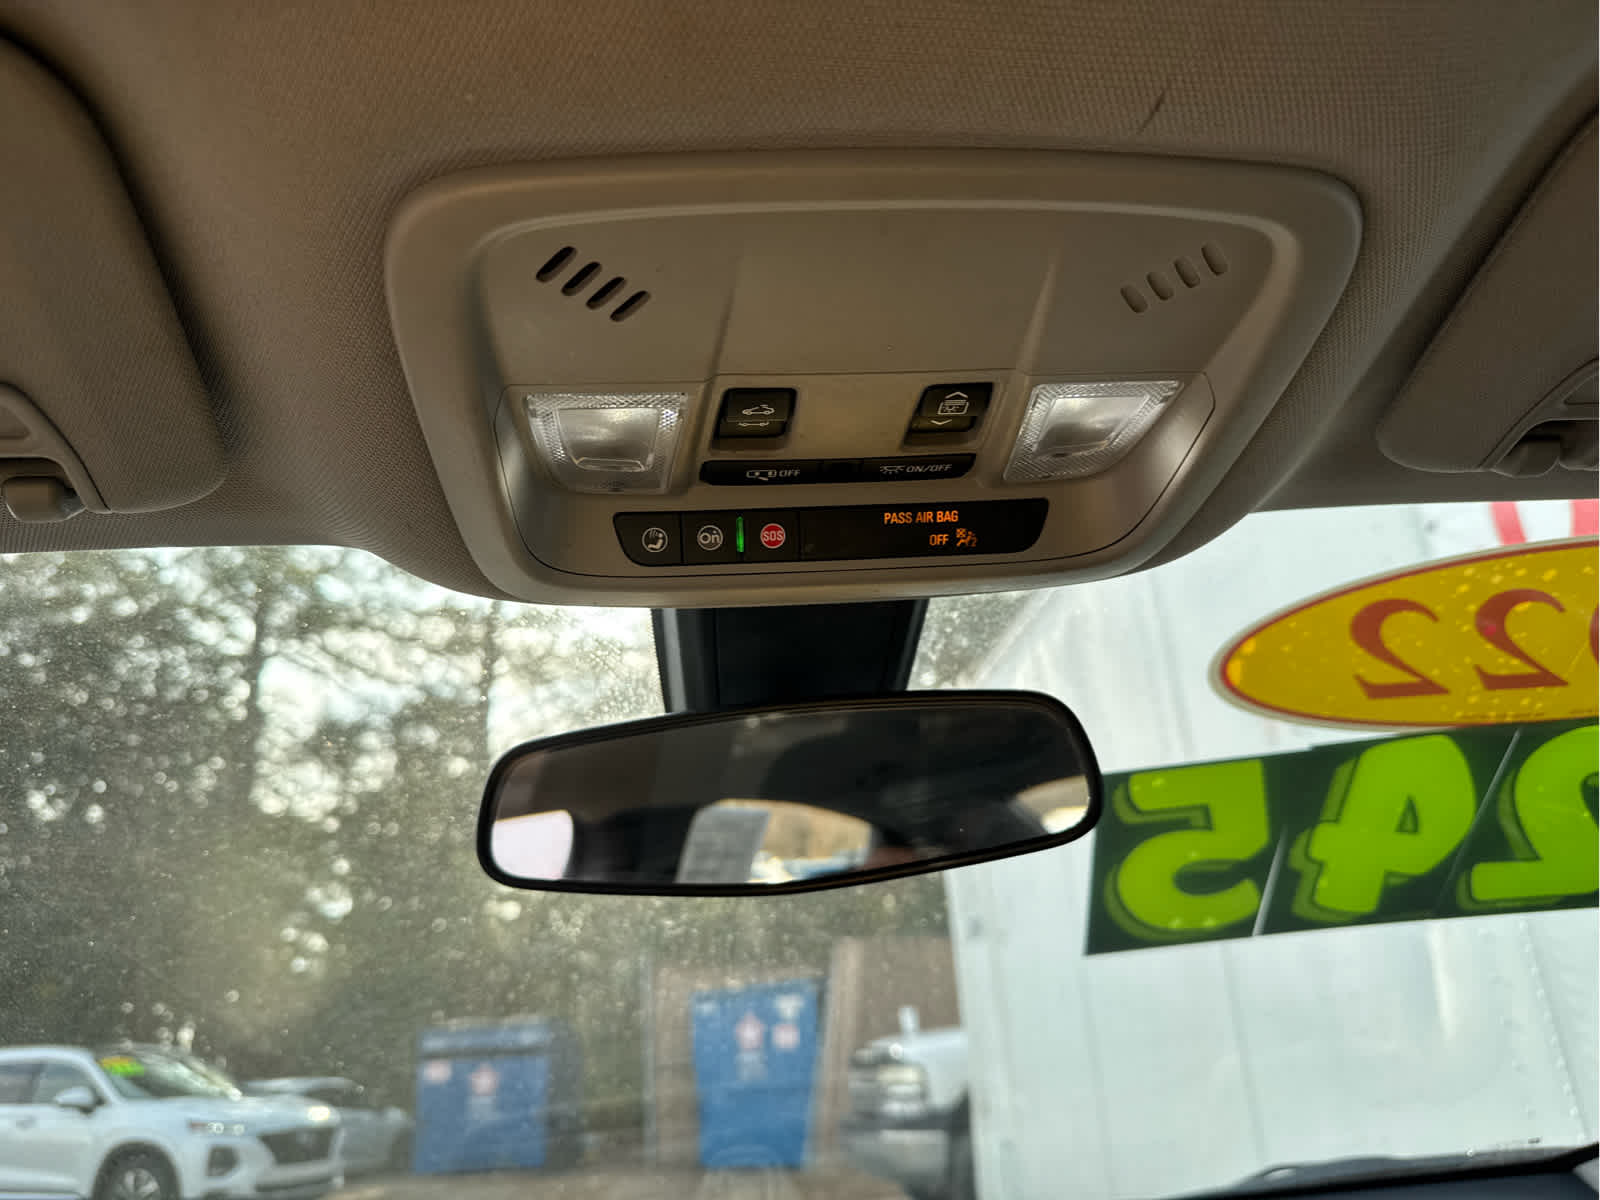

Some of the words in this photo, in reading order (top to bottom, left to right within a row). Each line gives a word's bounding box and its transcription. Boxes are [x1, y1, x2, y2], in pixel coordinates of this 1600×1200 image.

[778, 468, 800, 478] OFF
[906, 463, 953, 474] ON/OFF
[883, 511, 913, 525] PASS
[915, 511, 934, 524] AIR
[936, 509, 959, 523] BAG
[762, 529, 784, 543] SOS
[928, 533, 949, 547] OFF
